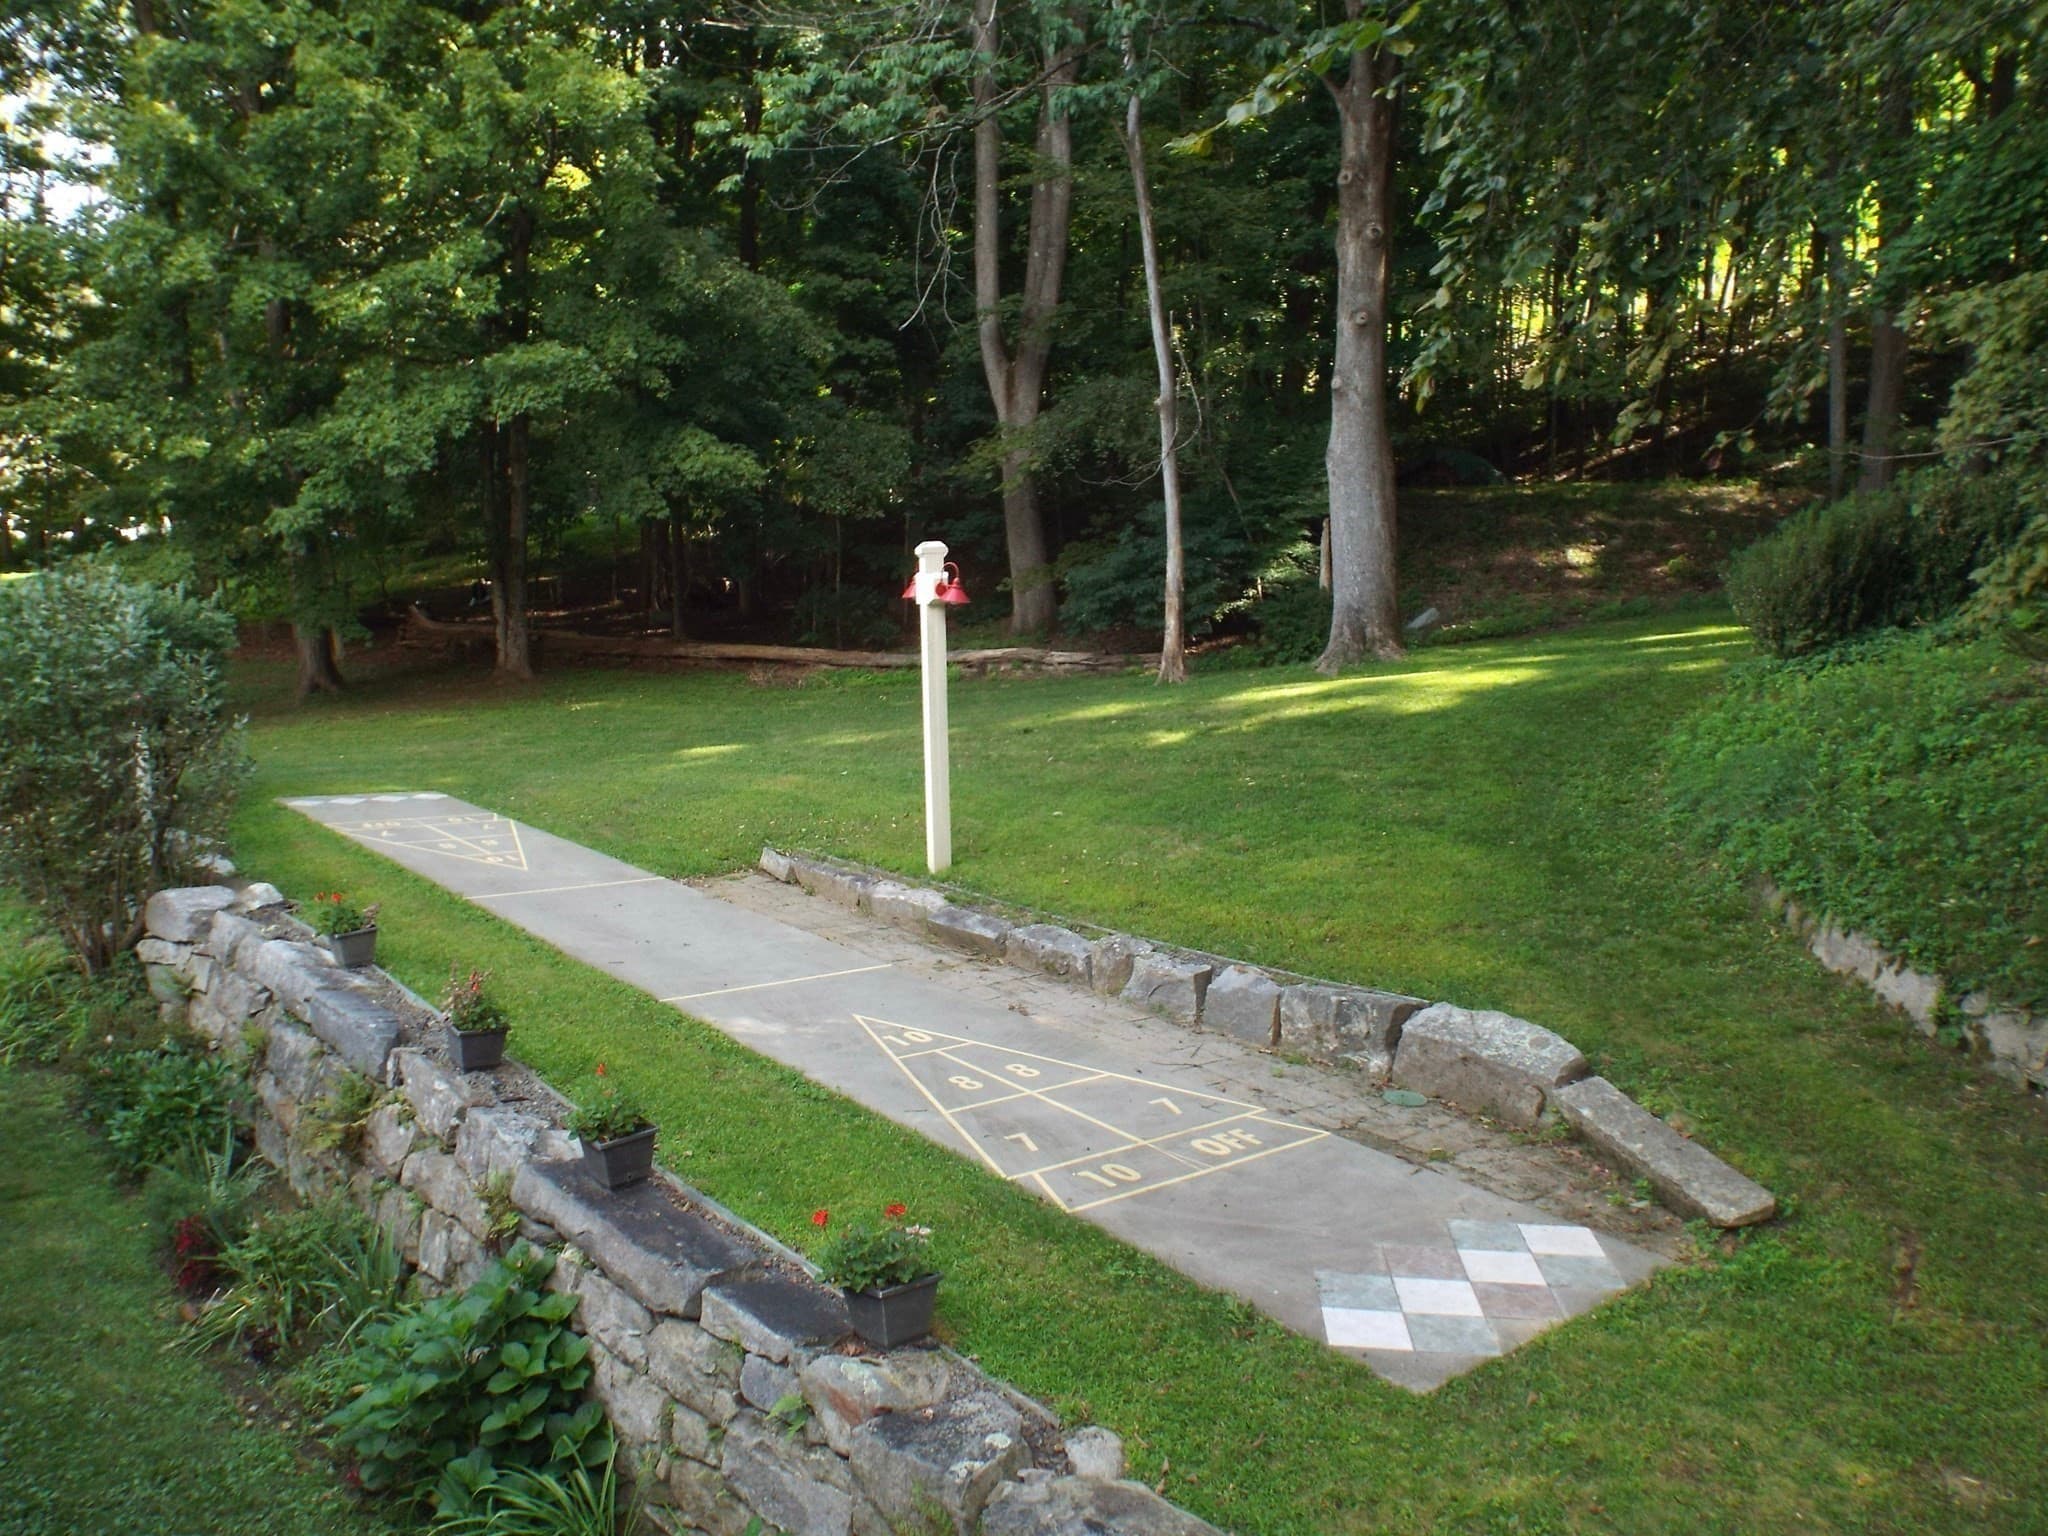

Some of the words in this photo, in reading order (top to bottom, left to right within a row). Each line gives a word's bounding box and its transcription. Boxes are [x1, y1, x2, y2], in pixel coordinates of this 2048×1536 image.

[882, 1031, 933, 1046] 10
[1004, 1063, 1041, 1078] 8
[948, 1075, 984, 1090] 8
[1149, 1097, 1183, 1115] 7
[1003, 1132, 1039, 1152] 7
[1190, 1128, 1263, 1156] OFF
[1078, 1163, 1142, 1188] 10
